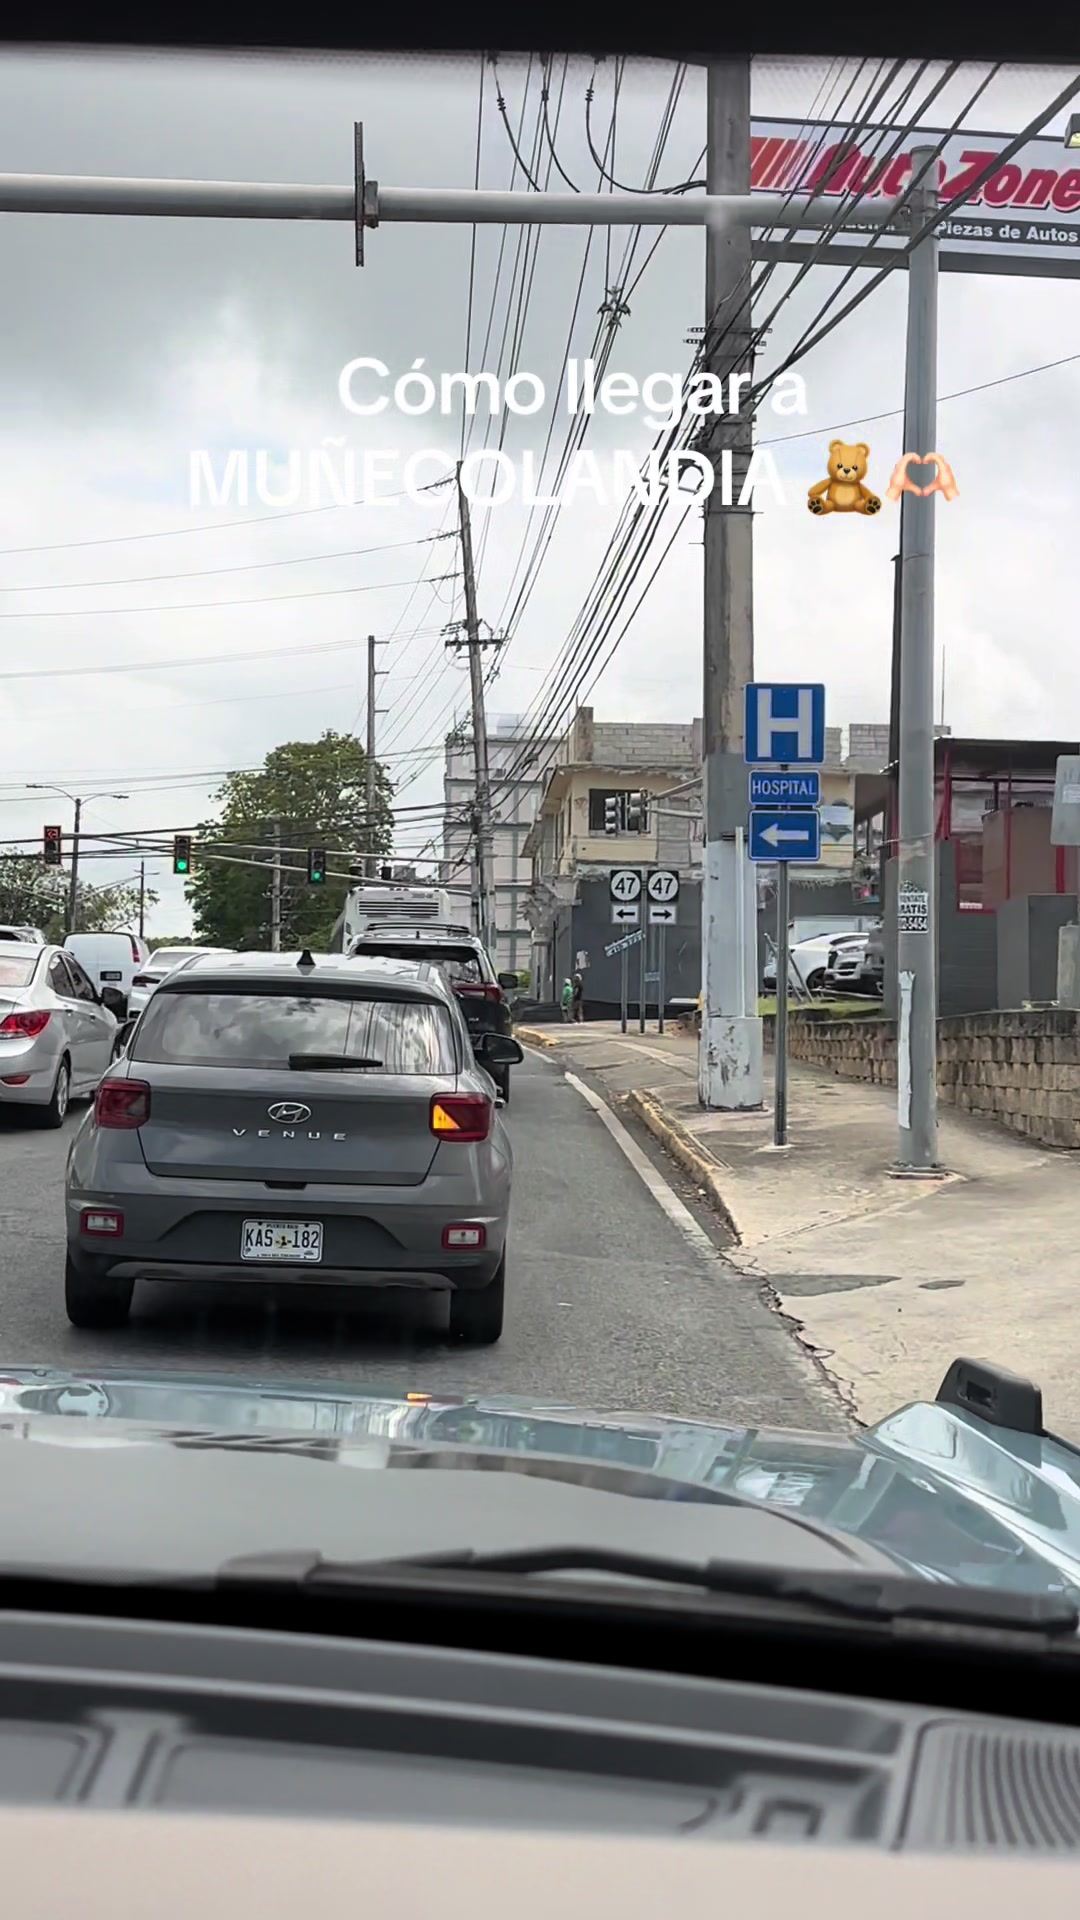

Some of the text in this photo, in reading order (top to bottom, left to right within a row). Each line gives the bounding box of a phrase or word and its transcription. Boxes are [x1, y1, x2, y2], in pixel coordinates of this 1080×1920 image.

[804, 142, 1080, 213] AutZone
[934, 220, 1078, 243] Piezas de Autos
[757, 688, 813, 759] H
[752, 780, 817, 795] HOSPITAL
[614, 877, 637, 894] 47
[652, 877, 674, 894] 47
[232, 1128, 347, 1140] VENUE
